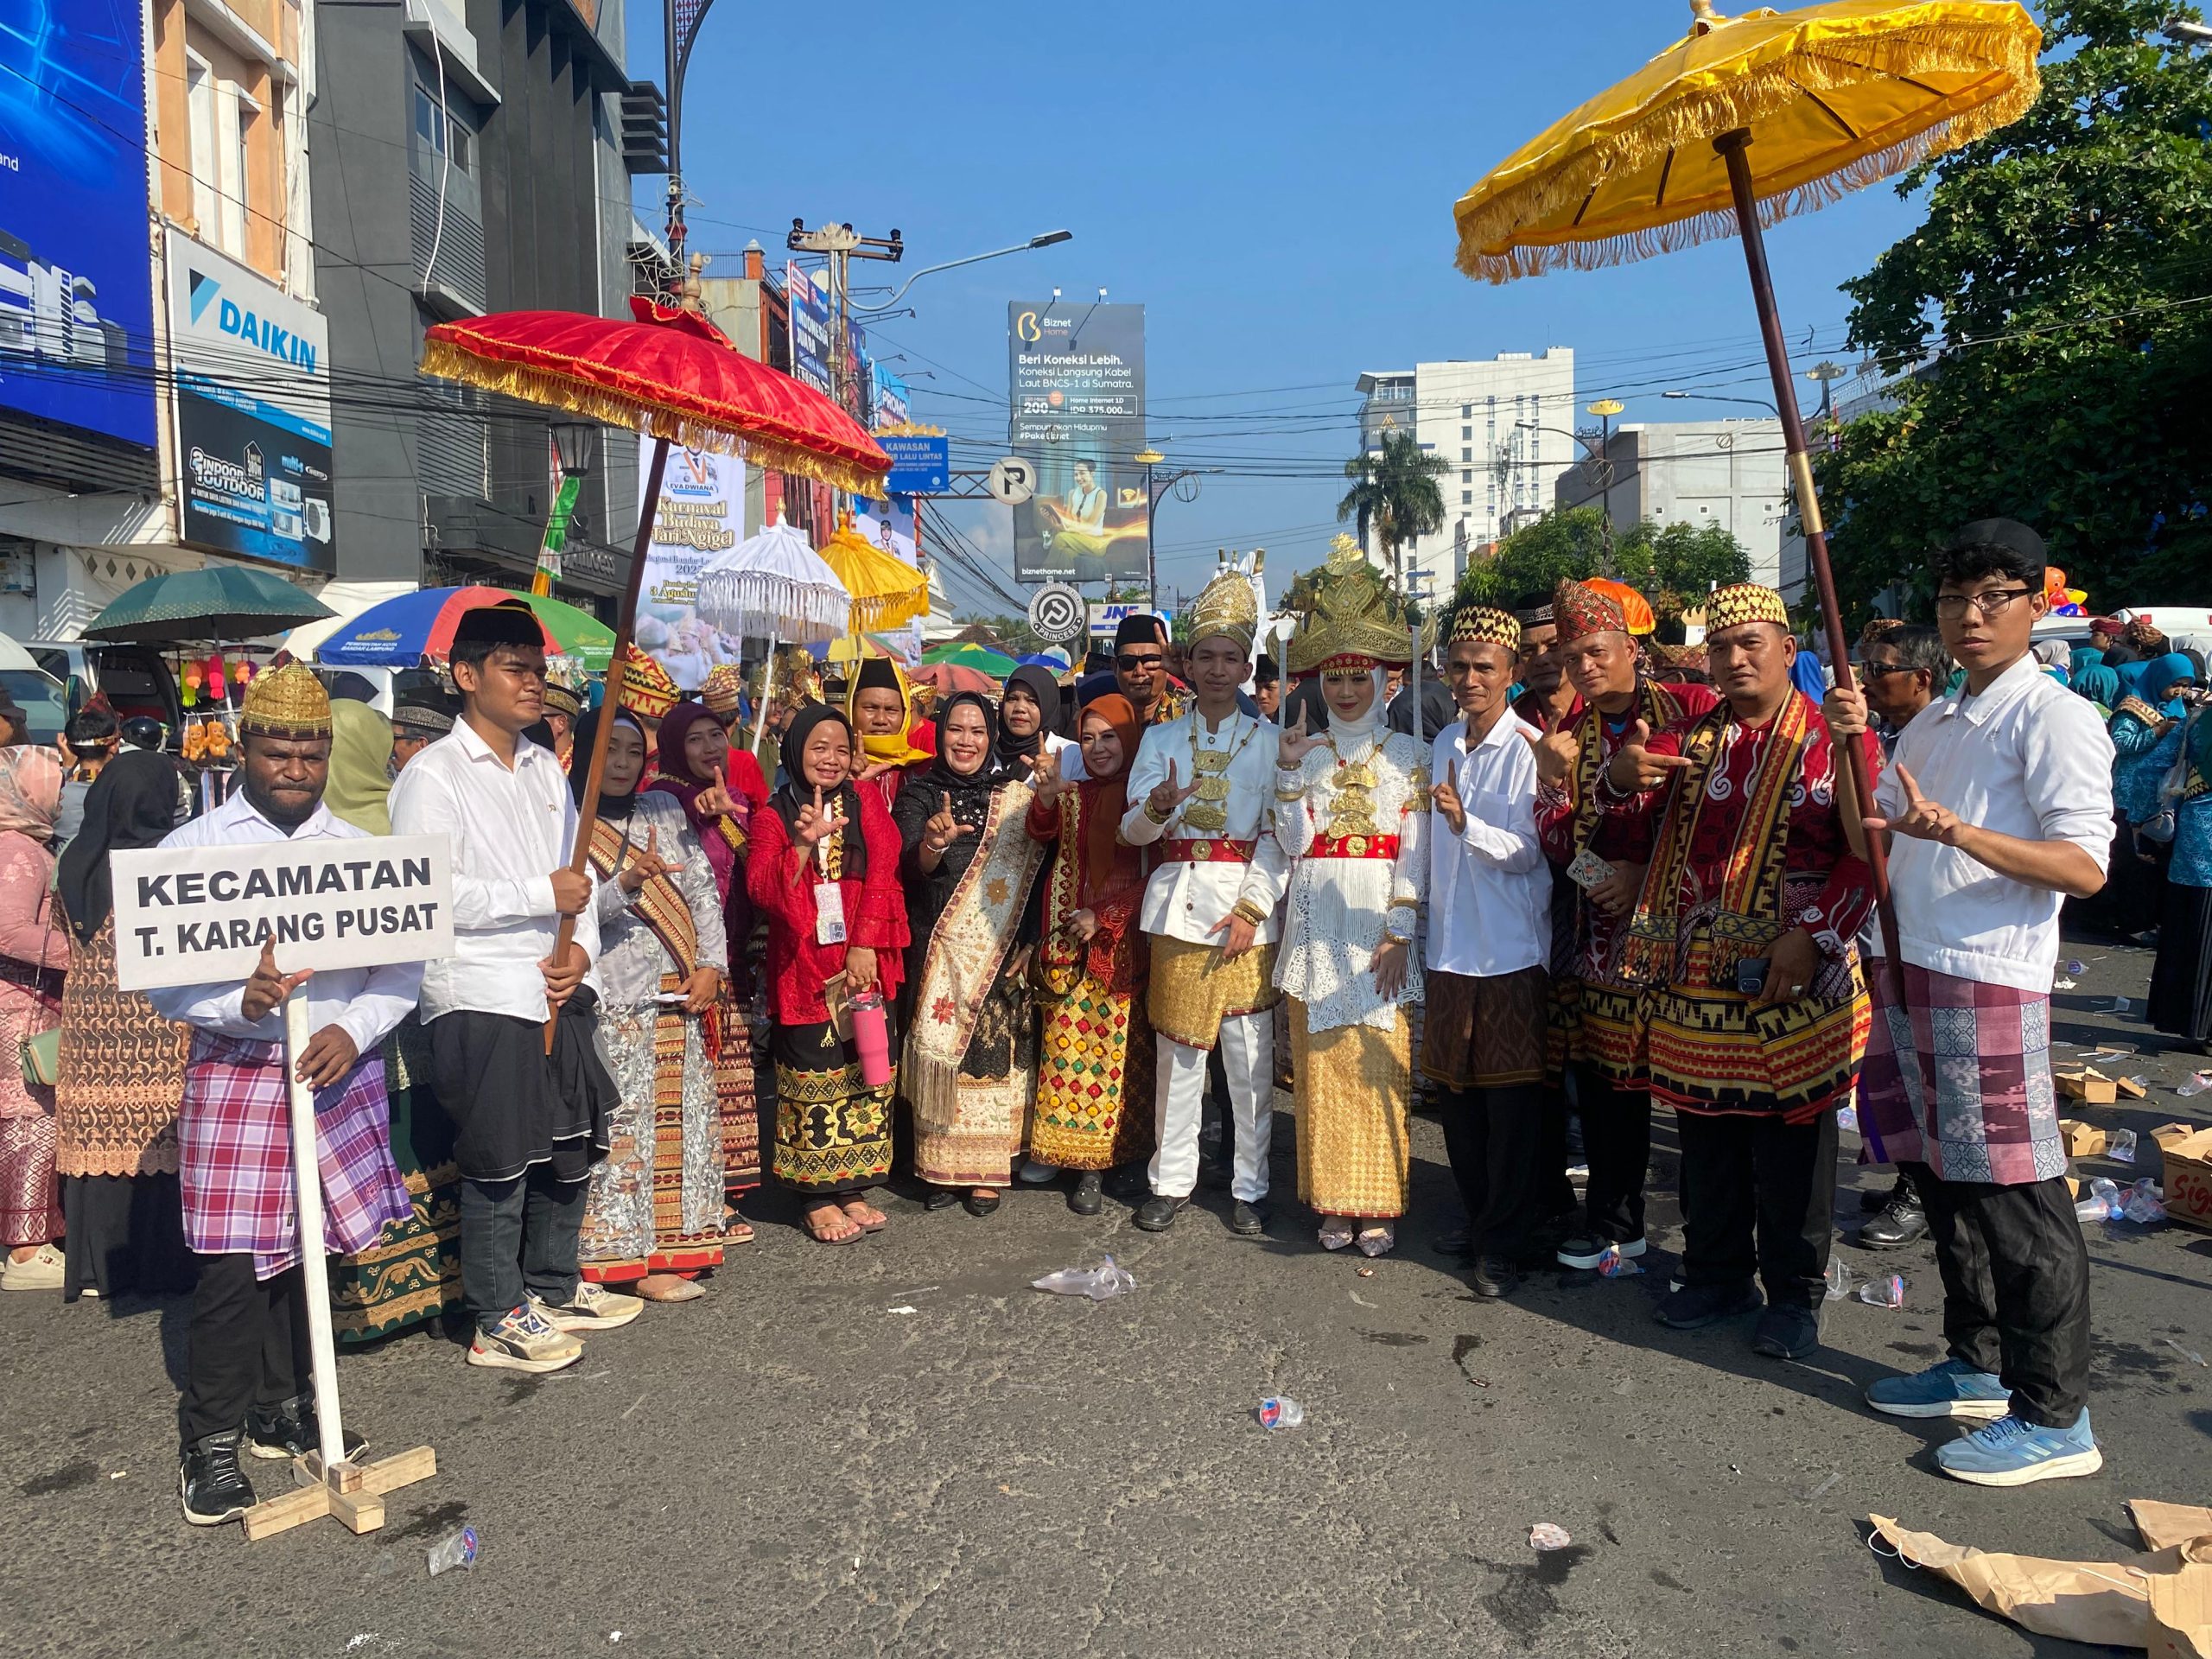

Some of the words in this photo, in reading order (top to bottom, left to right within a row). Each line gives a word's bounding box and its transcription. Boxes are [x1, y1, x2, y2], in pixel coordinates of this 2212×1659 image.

[796, 306, 829, 347] INDONESIA
[1043, 318, 1071, 327] Biznet
[219, 297, 316, 374] DAIKIN
[1044, 327, 1069, 336] Home
[797, 327, 817, 356] JUARA
[1018, 354, 1040, 365] Beri
[1044, 354, 1087, 365] Koneksi
[1090, 354, 1123, 365] Lebih.
[1018, 367, 1055, 377] Koneksi
[1057, 367, 1103, 378] Langsung
[1104, 367, 1132, 377] Kabel
[1019, 379, 1040, 388] Laut
[1043, 379, 1079, 388] BNCS-1
[1082, 379, 1090, 388] di
[1092, 379, 1134, 388] Sumatra.
[881, 387, 908, 423] PROMO
[1024, 402, 1049, 414] 200
[1088, 406, 1123, 415] 375.000
[1073, 423, 1108, 432] Hidupmu
[886, 442, 931, 452] KAWASAN
[658, 498, 728, 518] Karnaval
[663, 513, 720, 531] Budaya
[652, 526, 680, 544] Tari
[681, 528, 734, 550] Ngigel
[659, 588, 696, 601] Agustu
[1102, 606, 1139, 620] JNE
[1038, 624, 1079, 640] PRINCESS
[137, 857, 432, 908] KECAMATAN
[134, 926, 164, 957] T.
[177, 912, 325, 954] KARANG
[335, 902, 438, 938] PUSAT
[2171, 1173, 2212, 1215] Sig
